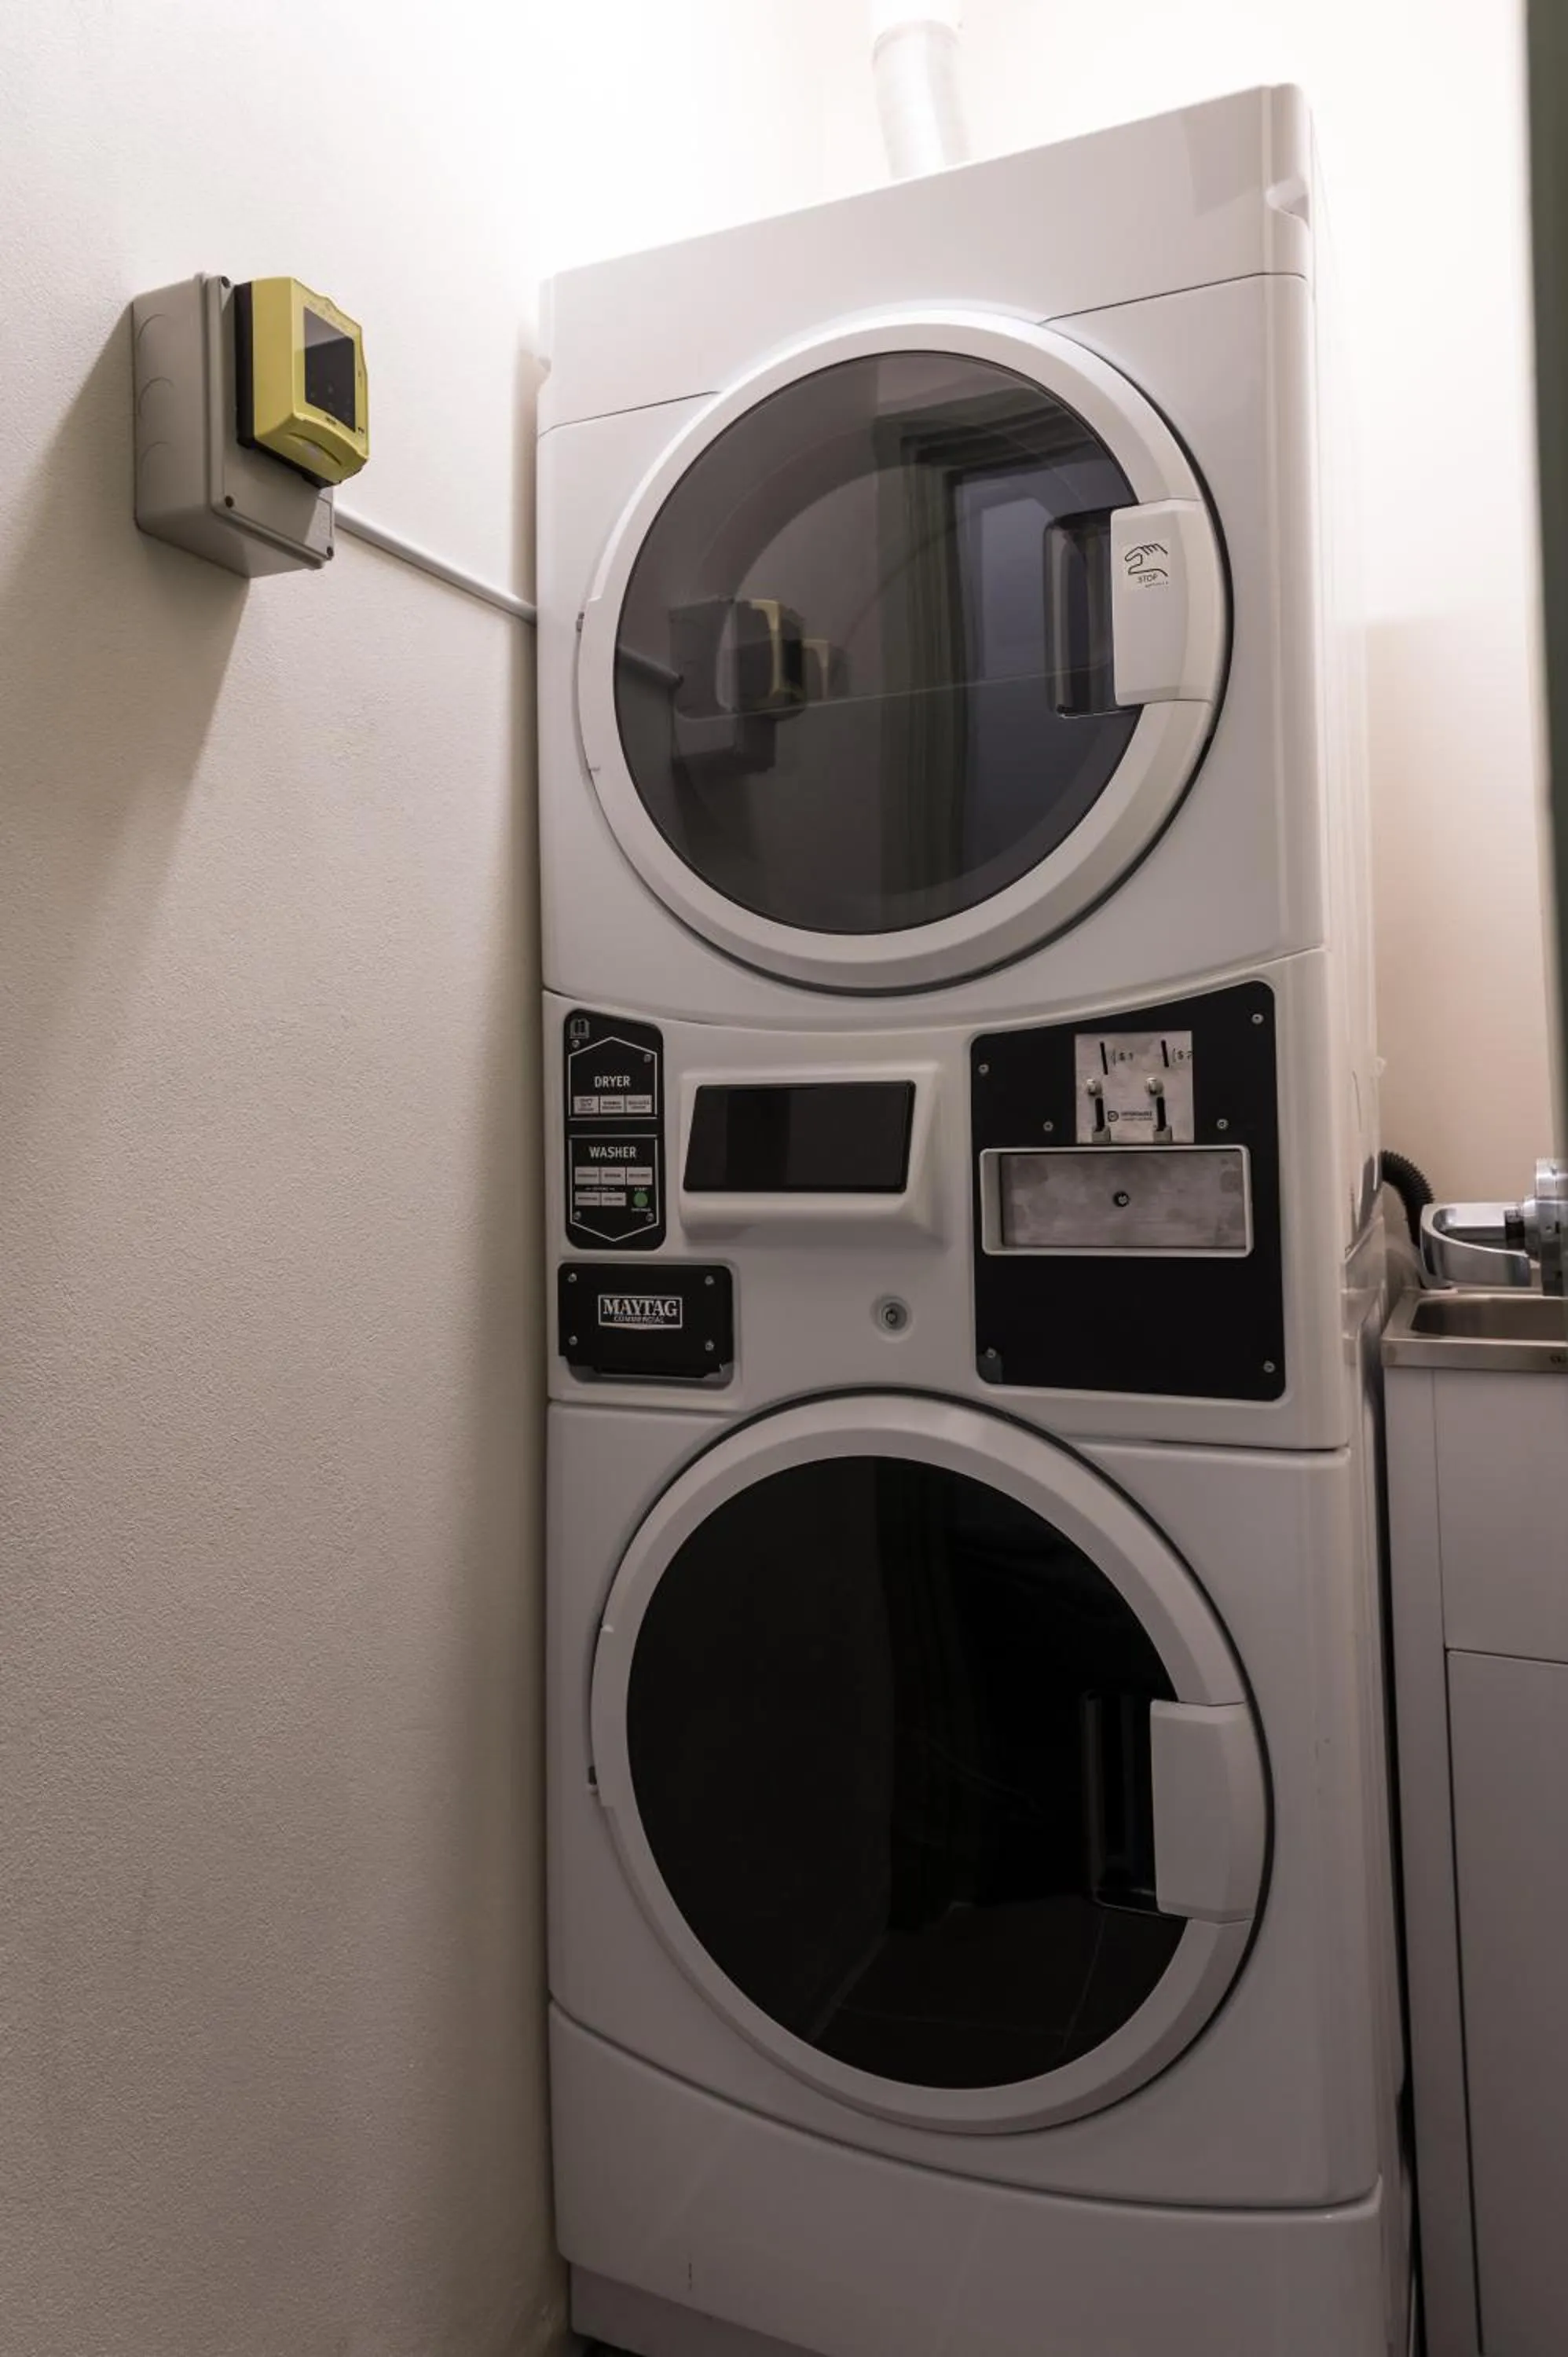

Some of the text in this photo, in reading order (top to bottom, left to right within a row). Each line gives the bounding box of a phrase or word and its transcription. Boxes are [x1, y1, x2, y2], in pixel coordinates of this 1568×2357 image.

[1137, 573, 1157, 583] STOP
[594, 1076, 631, 1088] DRYER
[589, 1146, 637, 1158] WASHER
[603, 1299, 680, 1317] MAYTAG
